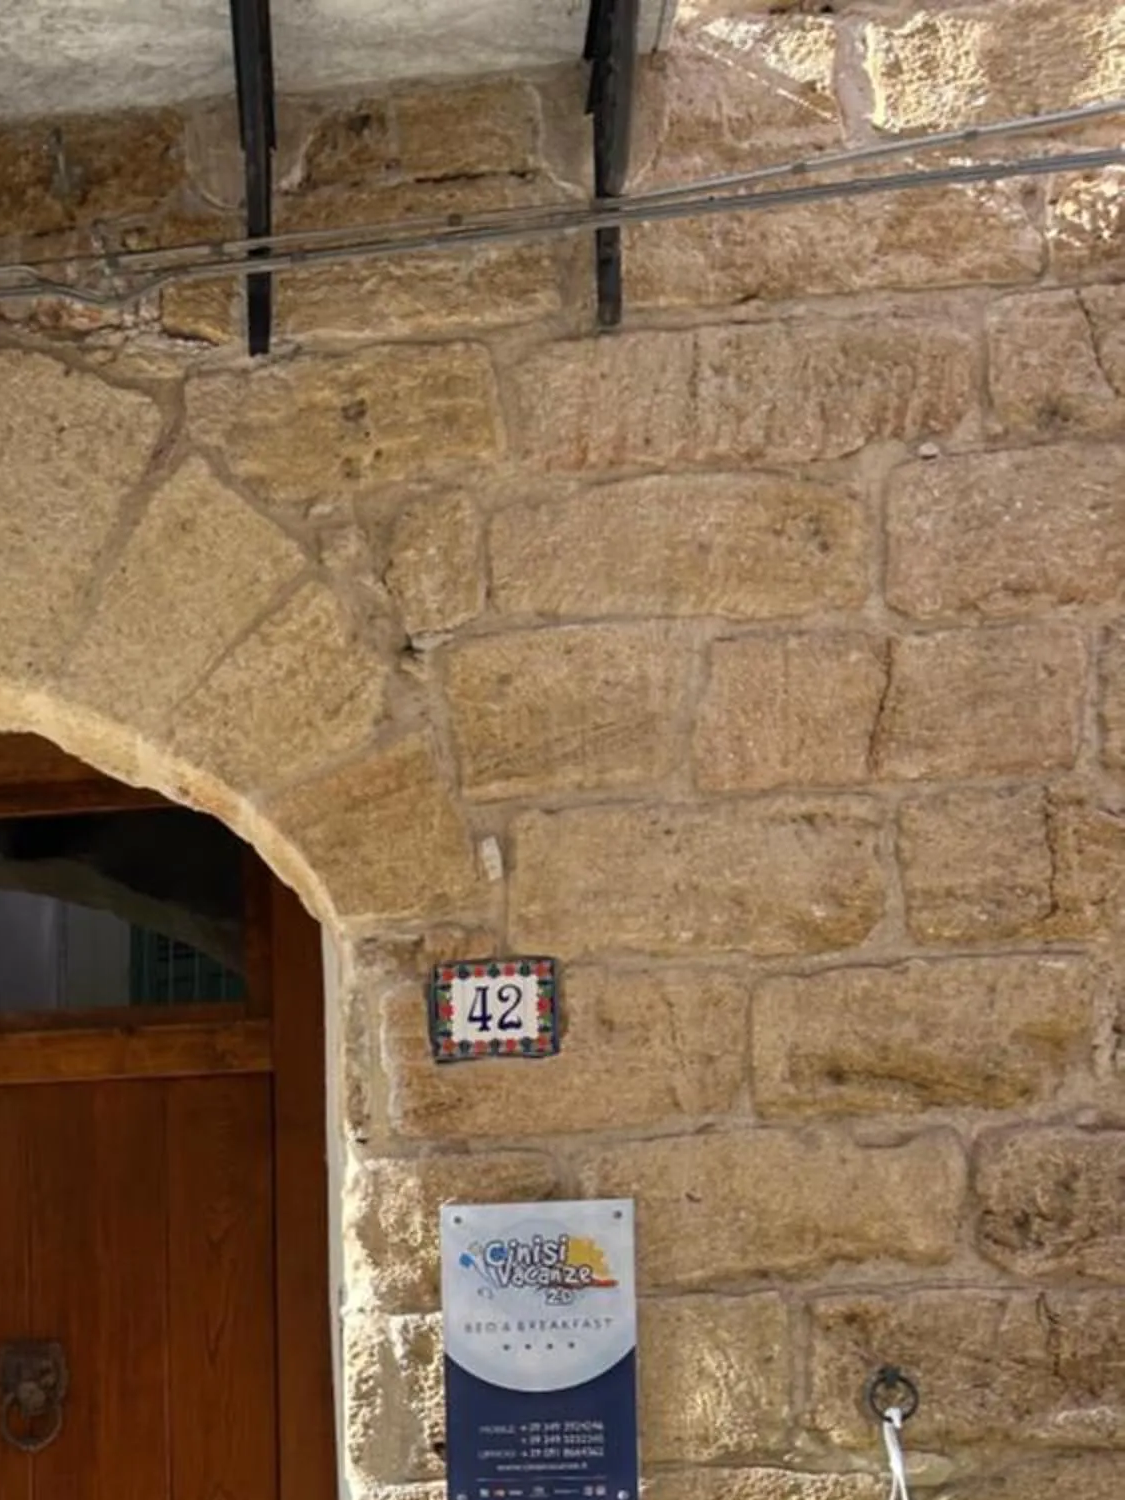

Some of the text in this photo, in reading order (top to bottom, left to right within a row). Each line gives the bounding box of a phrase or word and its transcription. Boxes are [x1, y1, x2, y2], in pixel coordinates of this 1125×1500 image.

[467, 984, 523, 1032] 42
[484, 1233, 569, 1268] Cinisi
[491, 1263, 593, 1289] Vacanze
[517, 1317, 613, 1333] BREAKFAST
